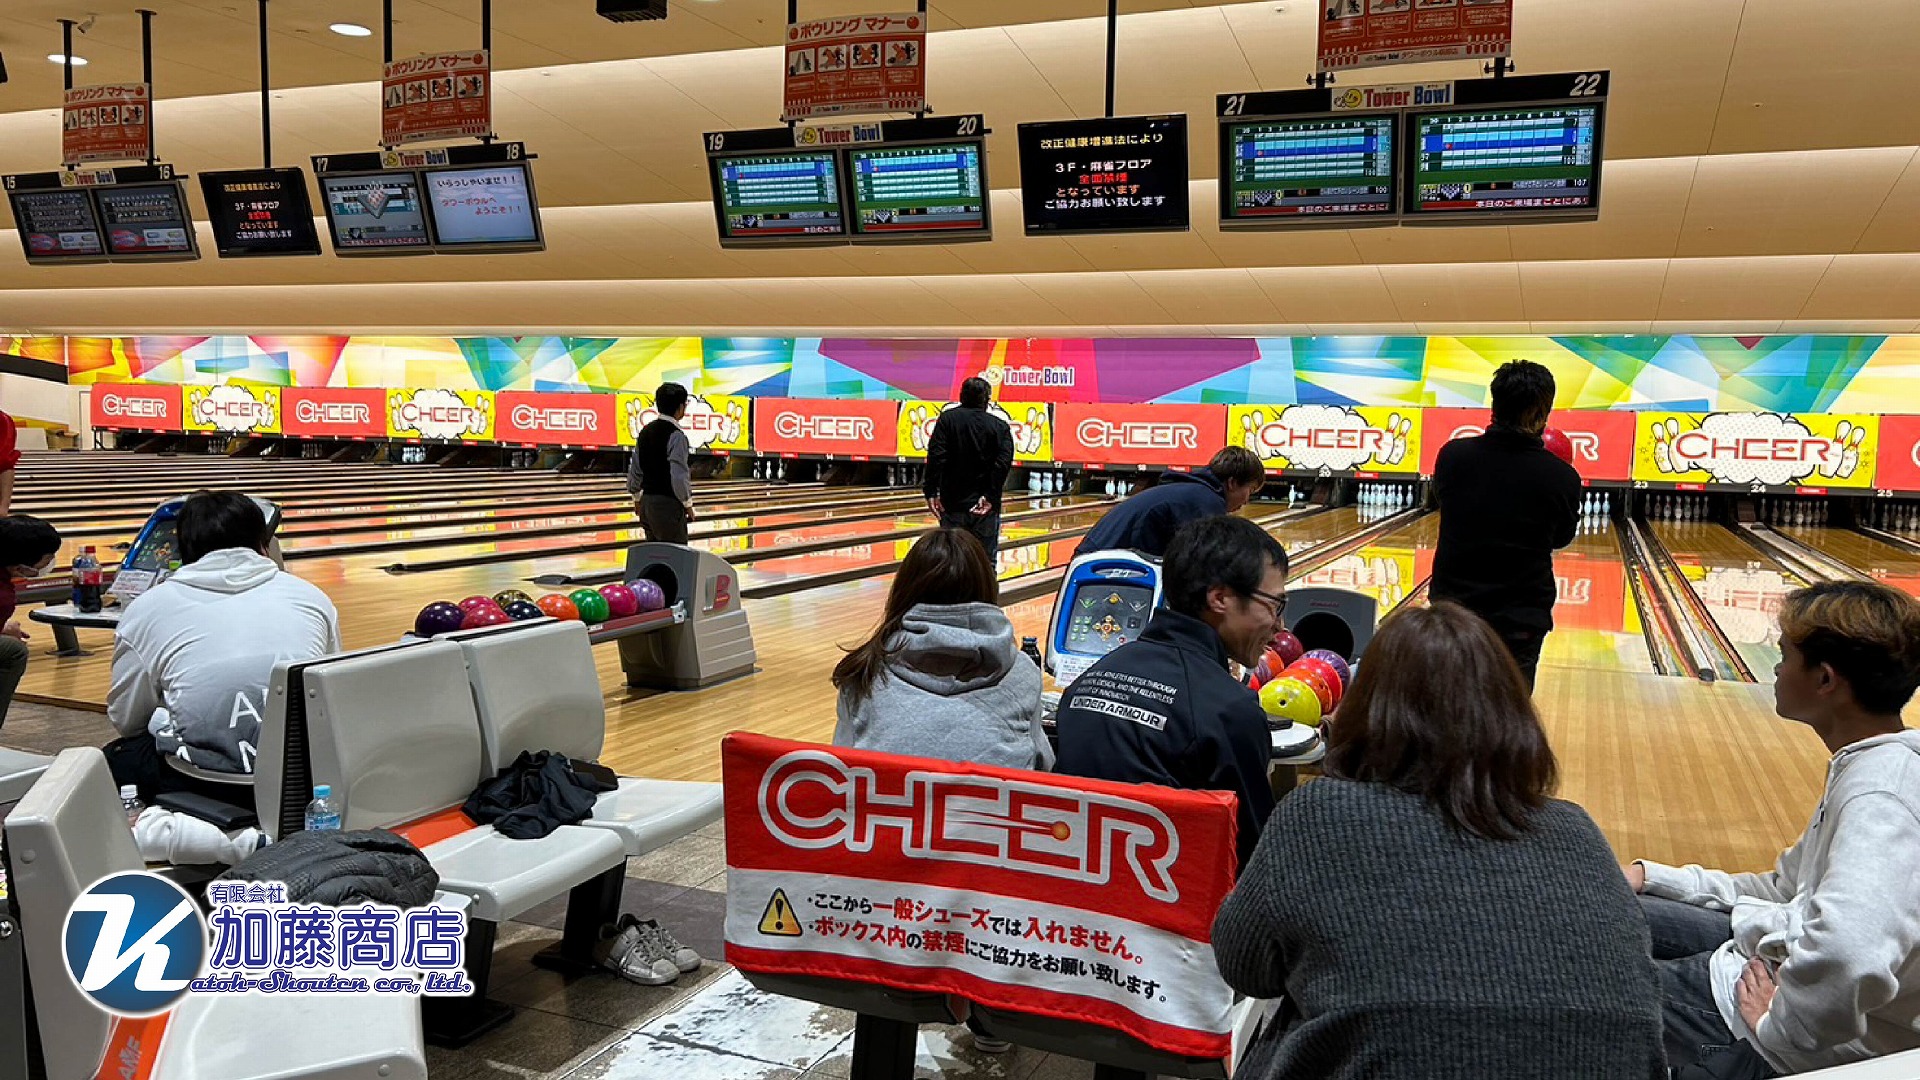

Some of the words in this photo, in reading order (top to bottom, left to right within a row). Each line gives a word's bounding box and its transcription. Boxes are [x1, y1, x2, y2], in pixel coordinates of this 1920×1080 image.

[801, 17, 861, 38] ボウリング
[864, 16, 905, 30] マナー
[1364, 88, 1410, 107] Tower
[1414, 84, 1451, 104] Bowl
[1569, 74, 1601, 96] 22
[1224, 95, 1246, 115] 21
[817, 127, 850, 143] Tower
[853, 123, 880, 141] Bowl
[957, 116, 977, 135] 20
[506, 144, 519, 160] 18
[709, 133, 723, 150] 19
[159, 165, 170, 179] 16
[316, 157, 329, 171] 17
[6, 176, 16, 190] 15
[1056, 185, 1140, 198] となっています
[1004, 367, 1041, 384] Tower
[1044, 367, 1074, 384] Bowl
[102, 393, 167, 419] CHEER
[199, 397, 264, 419] CHEER
[296, 399, 370, 425] CHEER
[401, 400, 477, 425] CHEER
[511, 404, 598, 432] CHEER
[640, 409, 725, 431] CEER
[774, 411, 875, 441] CHEER
[1076, 417, 1197, 451] CHEER
[1259, 422, 1386, 452] CHEER
[1676, 427, 1834, 464] CHEER
[1751, 484, 1766, 493] 24
[1073, 697, 1106, 709] UNDER
[1106, 703, 1160, 727] ARMOUR
[757, 749, 1180, 903] CHEER
